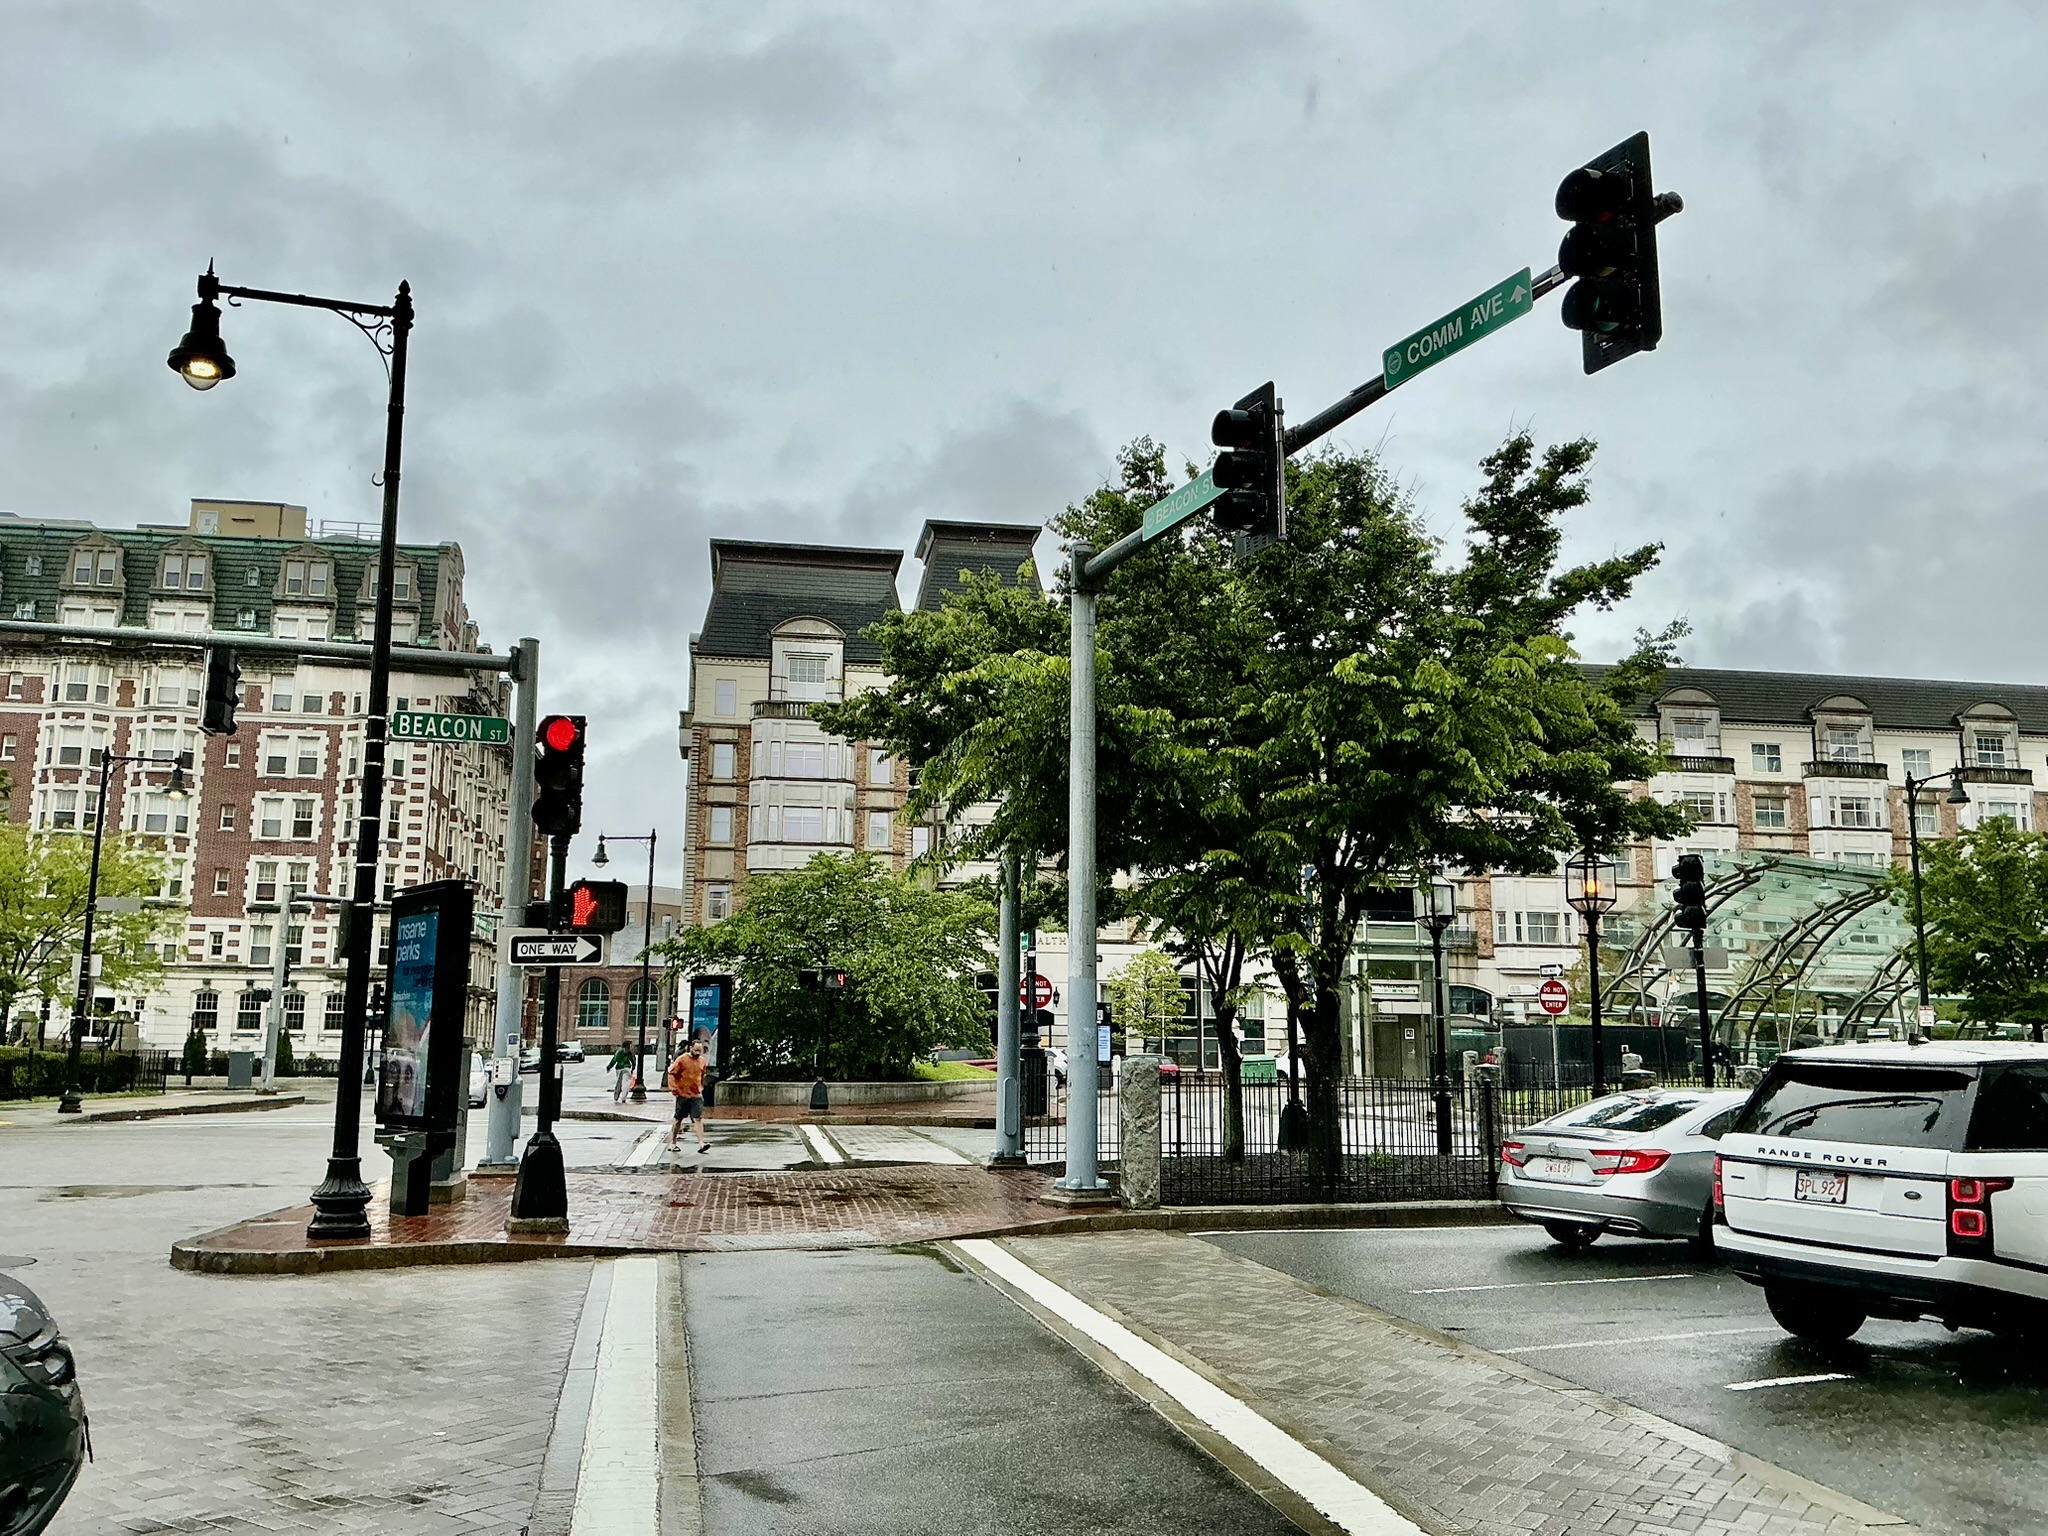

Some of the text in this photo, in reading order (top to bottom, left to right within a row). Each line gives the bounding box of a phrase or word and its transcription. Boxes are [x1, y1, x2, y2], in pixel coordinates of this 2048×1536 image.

[1407, 292, 1504, 364] COMM AVE
[1156, 484, 1199, 524] BEACON
[399, 714, 482, 739] BEACON
[395, 940, 420, 966] perks
[520, 944, 577, 955] ONE WAY
[1545, 1001, 1563, 1009] ENTER
[1757, 1147, 1888, 1166] RANGE ROVER
[1797, 1178, 1844, 1196] 3PL 927
